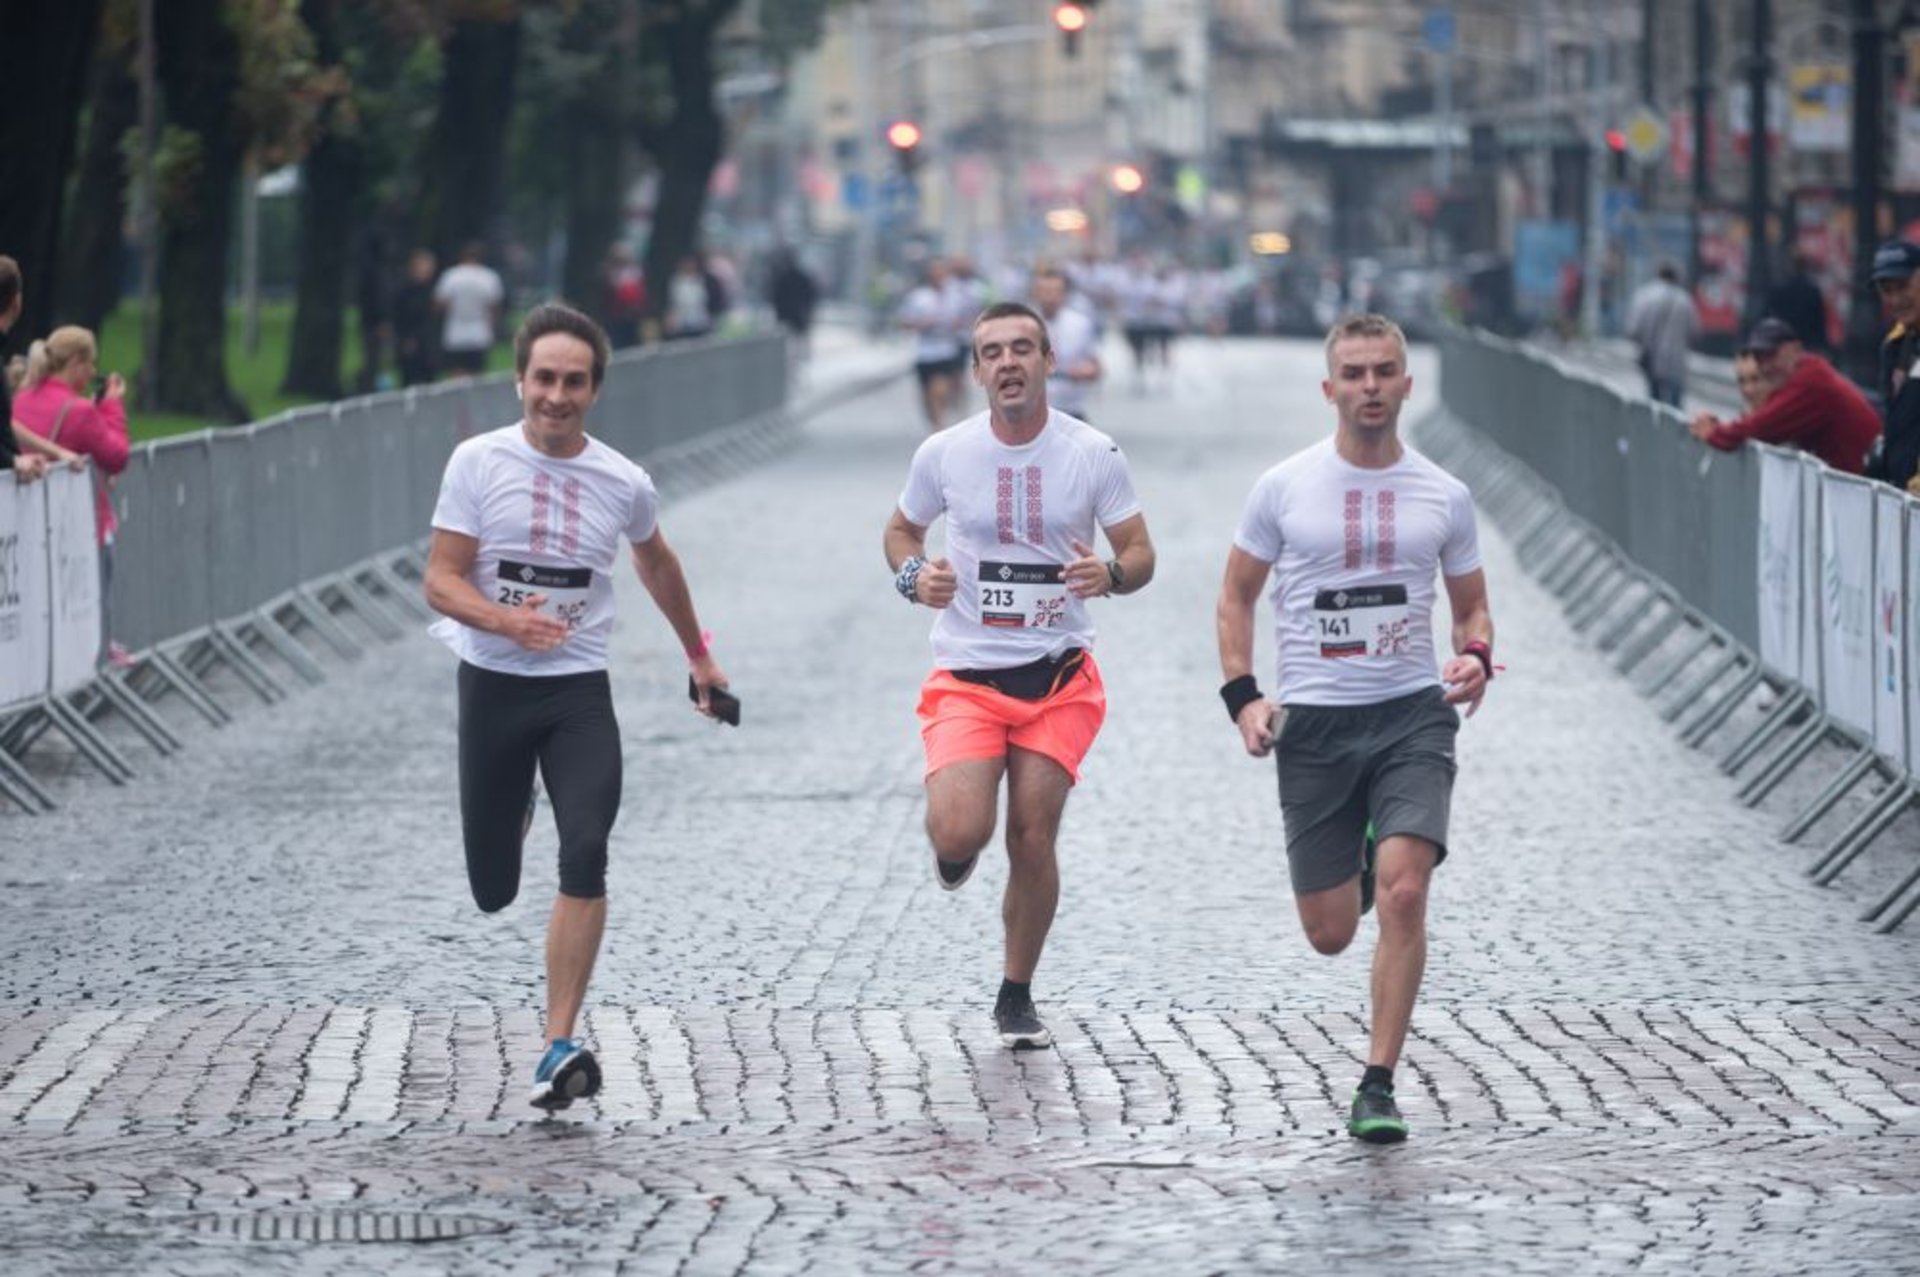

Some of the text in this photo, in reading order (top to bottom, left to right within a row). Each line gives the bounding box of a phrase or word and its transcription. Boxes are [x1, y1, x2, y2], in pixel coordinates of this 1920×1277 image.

[498, 587, 535, 606] 25
[982, 588, 1014, 607] 213
[1319, 617, 1350, 636] 141
